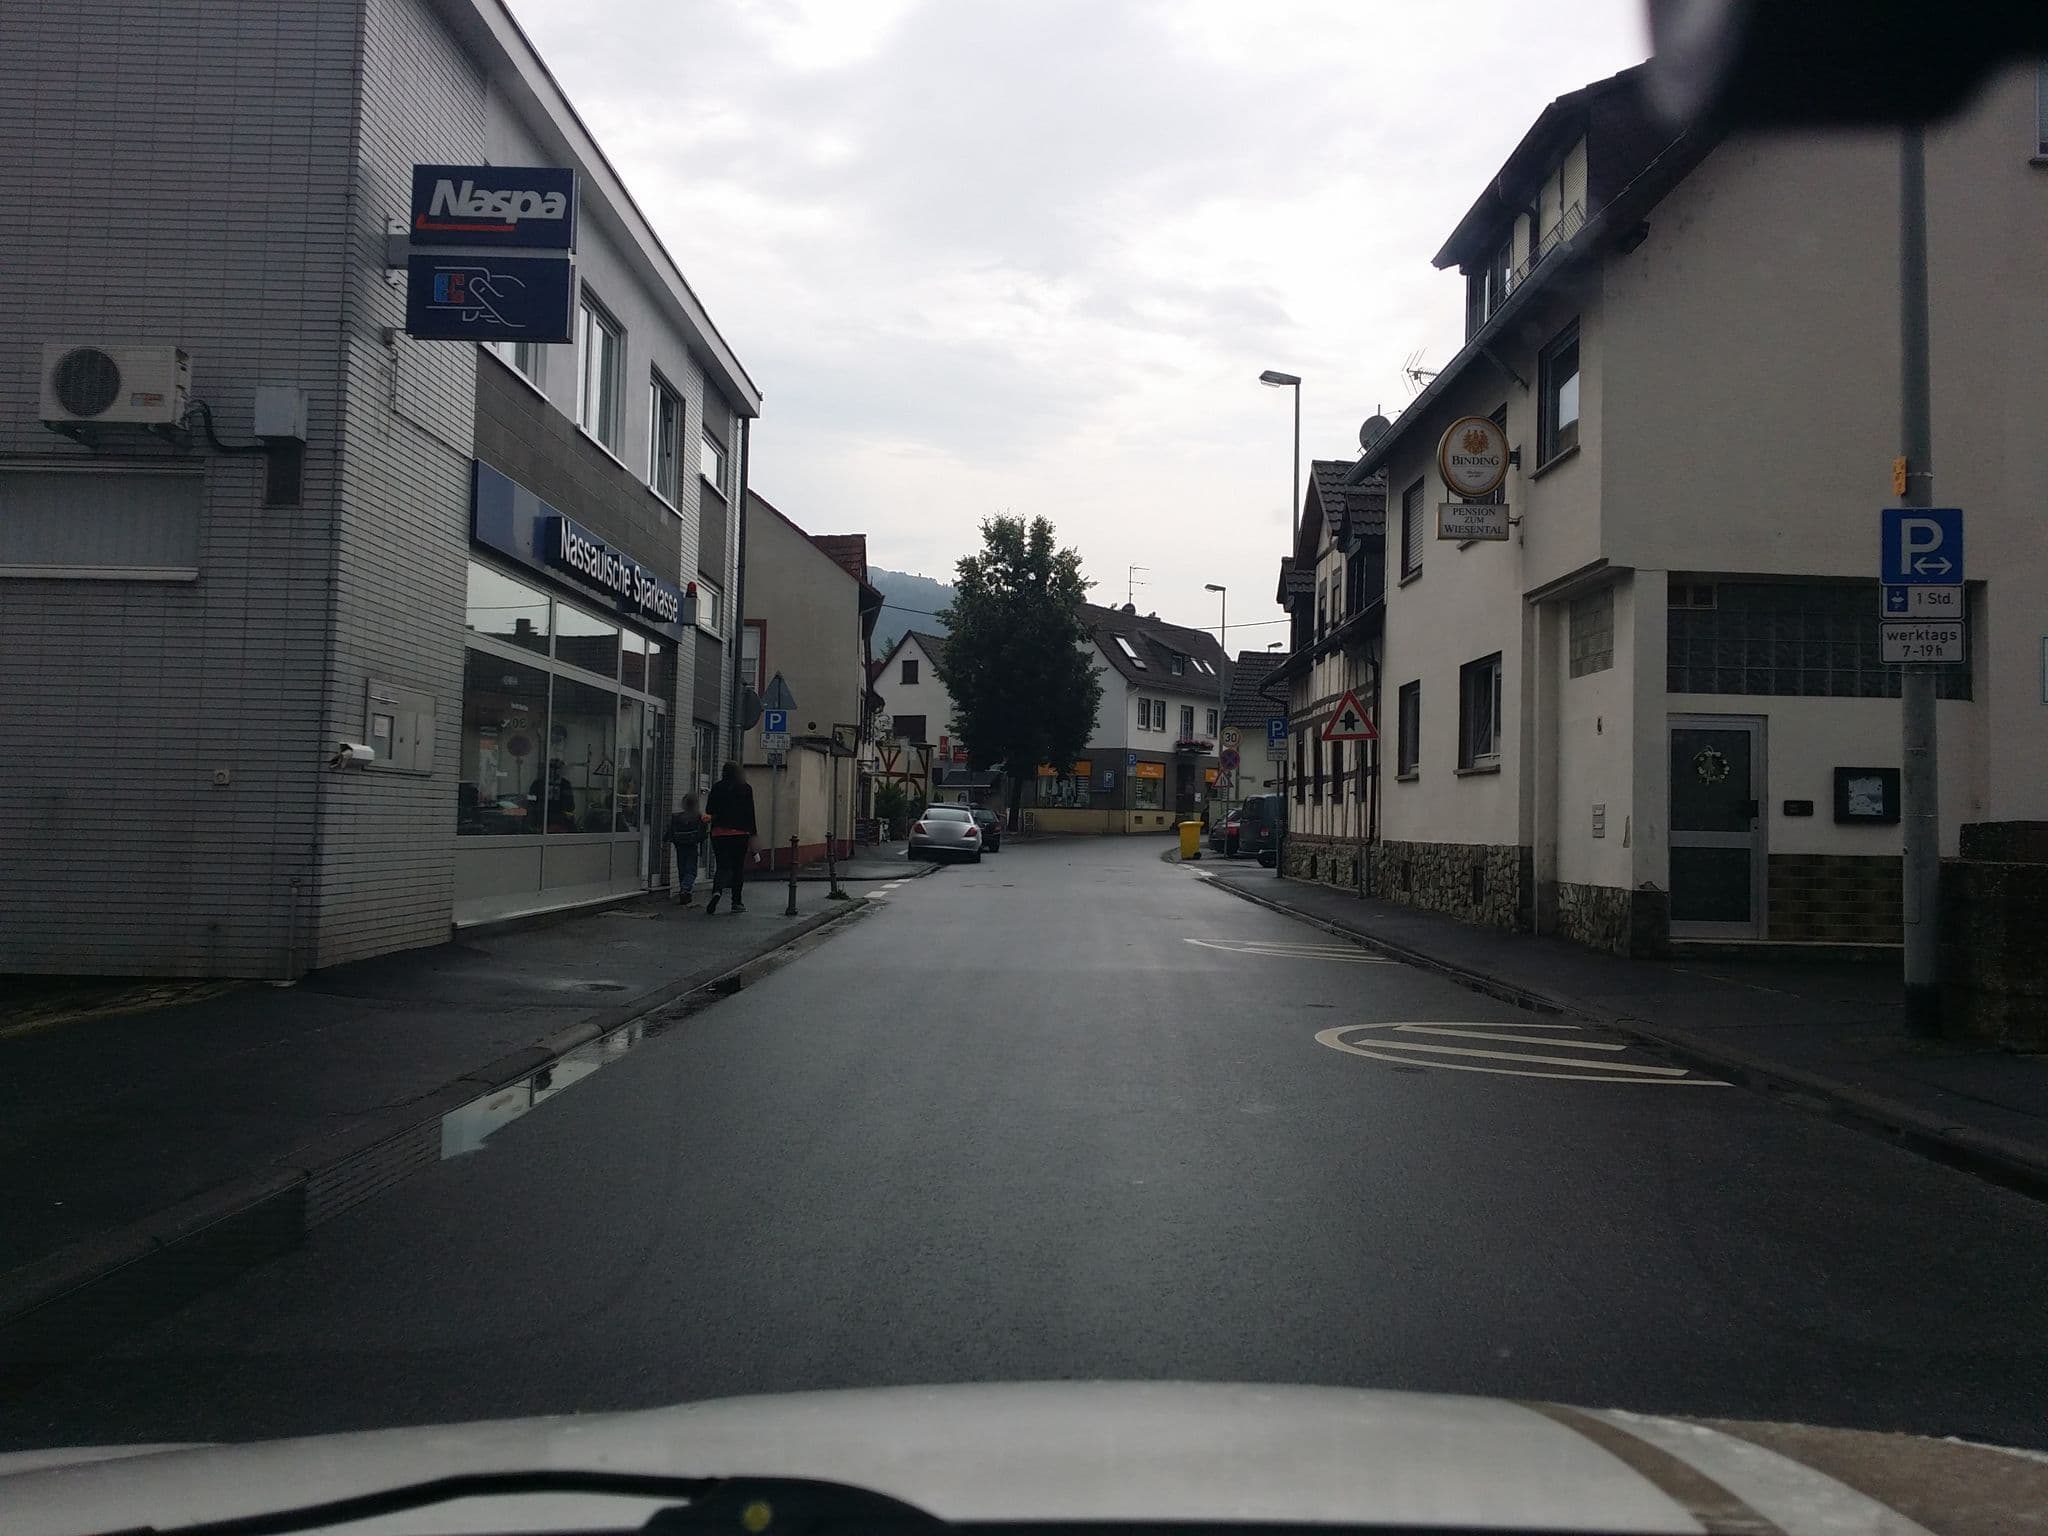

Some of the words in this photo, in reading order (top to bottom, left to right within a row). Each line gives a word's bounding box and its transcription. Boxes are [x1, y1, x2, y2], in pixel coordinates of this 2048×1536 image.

[429, 179, 567, 224] Naspa
[1452, 455, 1500, 466] BINDING
[1453, 507, 1496, 516] PENSION
[1444, 525, 1504, 534] WIESENTAL
[1901, 518, 1944, 575] P
[560, 518, 631, 598] Nassauische
[633, 565, 678, 623] Sparkasse
[1917, 594, 1922, 605] 1
[1928, 593, 1954, 605] Std.
[1887, 629, 1957, 644] werktags
[769, 713, 782, 730] P
[1272, 720, 1284, 737] P
[1225, 732, 1238, 743] 30
